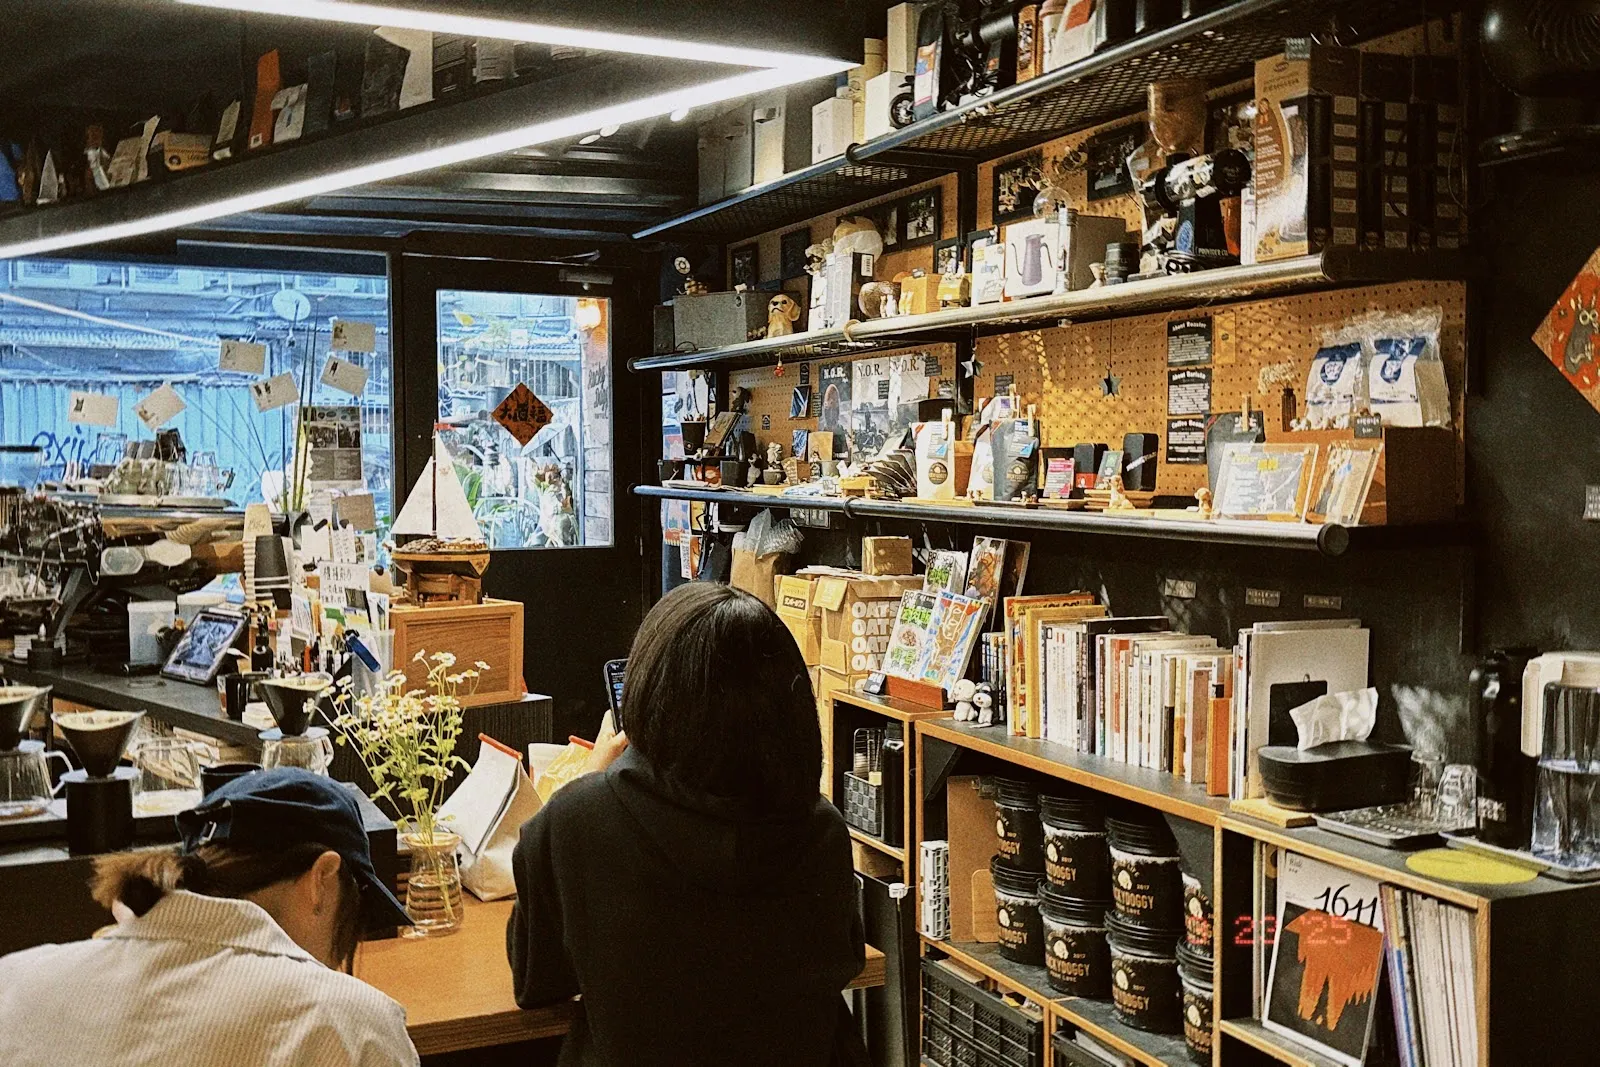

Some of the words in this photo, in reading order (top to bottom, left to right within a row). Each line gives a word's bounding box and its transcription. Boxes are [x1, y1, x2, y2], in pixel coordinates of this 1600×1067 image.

[1172, 322, 1186, 332] About
[1186, 320, 1207, 329] Roaster
[1172, 371, 1186, 382] About
[1186, 370, 1206, 380] Barista
[1171, 420, 1188, 430] Coffee
[851, 601, 902, 618] OATS
[851, 618, 896, 636] OAT
[1313, 883, 1378, 927] 1611
